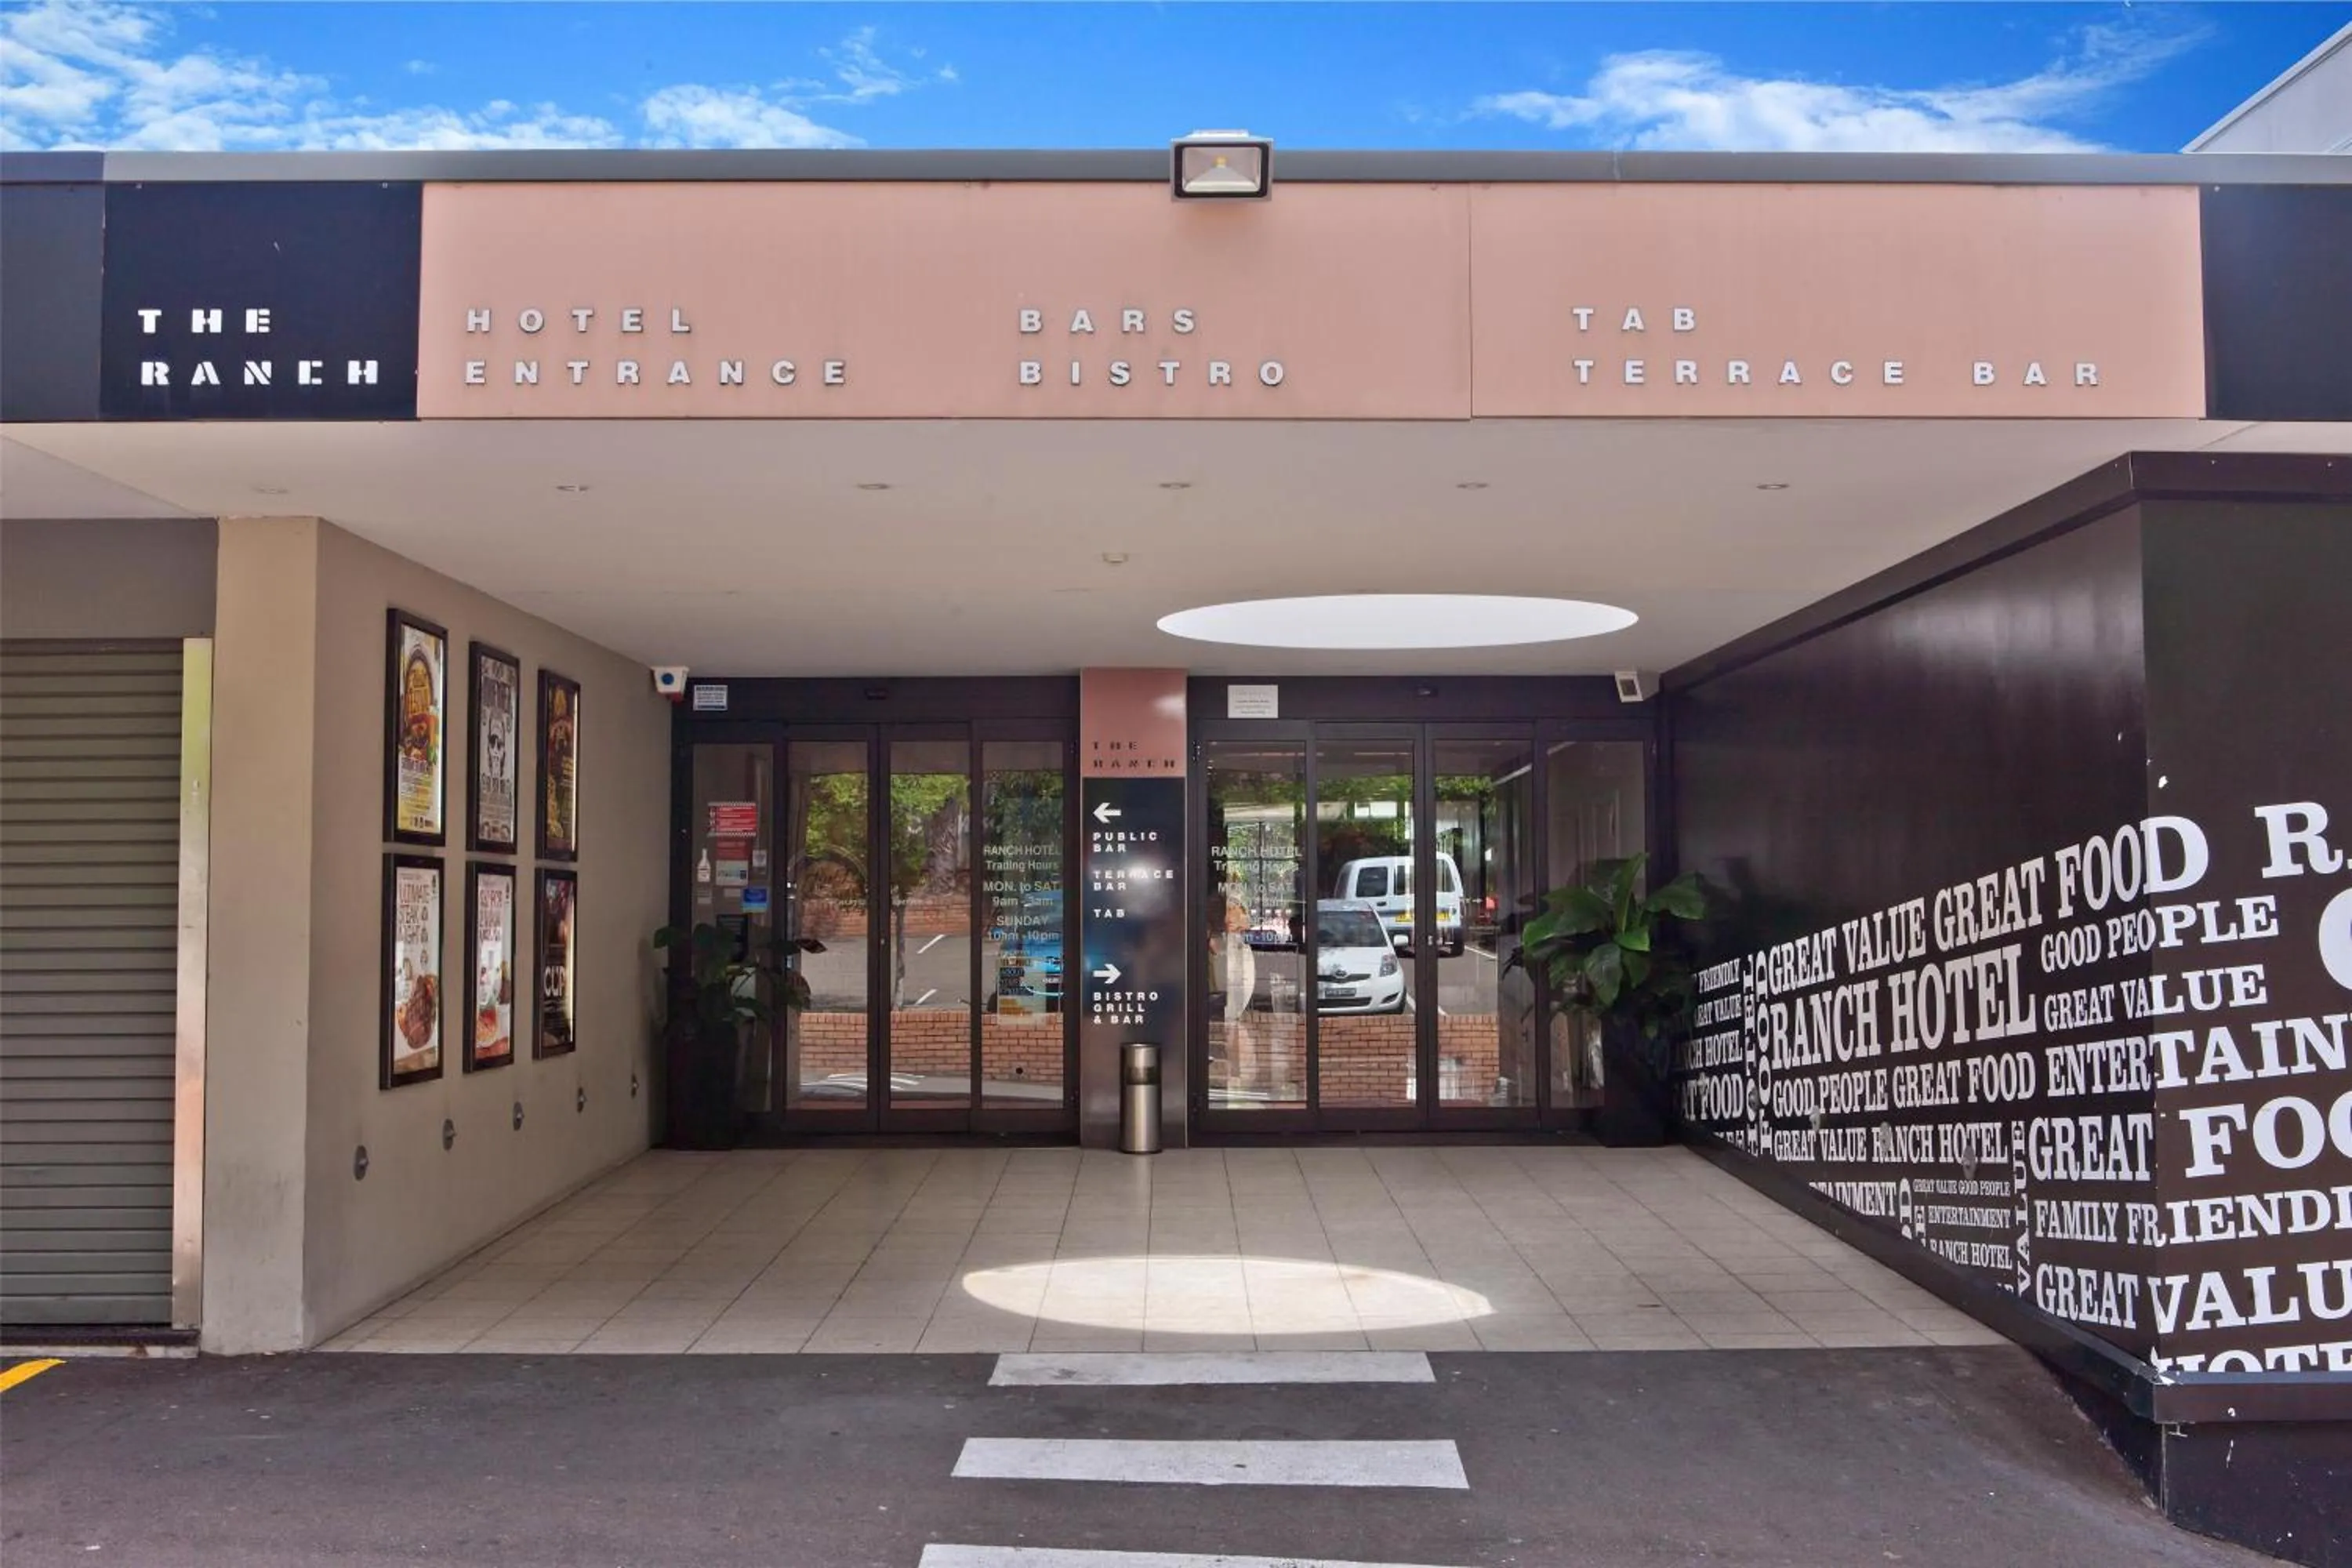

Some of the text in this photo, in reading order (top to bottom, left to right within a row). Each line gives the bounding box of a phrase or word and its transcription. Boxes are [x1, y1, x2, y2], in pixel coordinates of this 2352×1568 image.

[137, 309, 270, 333] THE
[466, 308, 691, 333] HOTEL
[1019, 309, 1195, 333] BARS
[1573, 307, 1697, 331] TAB
[140, 360, 379, 386] RANCH
[465, 360, 845, 385] ENTRANCE
[1018, 361, 1284, 386] BISTRO
[1573, 359, 2100, 386] TERRACE BAR
[1092, 741, 1138, 750] THE
[1093, 759, 1174, 768] RANCH
[1093, 832, 1158, 841] PUBLIC
[1093, 844, 1126, 853] BAR
[983, 845, 1062, 856] RANCH HOTEL
[1211, 846, 1257, 857] RANCH
[985, 860, 1025, 873] Trading
[982, 880, 1060, 892] MON. to SAT
[1094, 882, 1127, 891] BAR
[1769, 801, 2352, 996] GREAT VALUE GREAT FOOD R
[996, 915, 1049, 926] SUNDAY
[1093, 909, 1125, 918] TAB
[2041, 924, 2101, 974] GOOD
[2107, 895, 2280, 959] PEOPLE
[1698, 958, 1741, 993] FRIENDLY
[1093, 1004, 1145, 1012] GRILL
[1094, 992, 1159, 1001] BISTRO
[1714, 994, 1742, 1018] VALUE
[1770, 943, 2038, 1071] RANCH HOTEL
[2044, 964, 2268, 1033] GREAT VALUE
[1094, 1014, 1144, 1024] & BAR
[1704, 1029, 1743, 1066] HOTEL
[1755, 950, 1773, 1156] FOOD
[1773, 1077, 1815, 1119] GOOD
[1818, 1069, 1889, 1115] PEOPLE
[1893, 1059, 1961, 1109] GREAT
[1966, 1051, 2036, 1103] FOOD
[1774, 1129, 1816, 1163] GREAT
[1819, 1127, 1867, 1163] VALUE
[1871, 1124, 1934, 1163] RANCH
[1937, 1121, 2008, 1164] HOTEL
[2028, 1112, 2154, 1181] GREAT
[1958, 1179, 1980, 1196] GOOD
[1980, 1181, 2011, 1198] PEOPLE
[1928, 1205, 2011, 1229] ENTERTAINMENT
[2011, 1120, 2031, 1298] VALUE
[2034, 1200, 2119, 1243] FAMILY
[1971, 1243, 2013, 1270] HOTEL
[2036, 1263, 2139, 1330] GREAT
